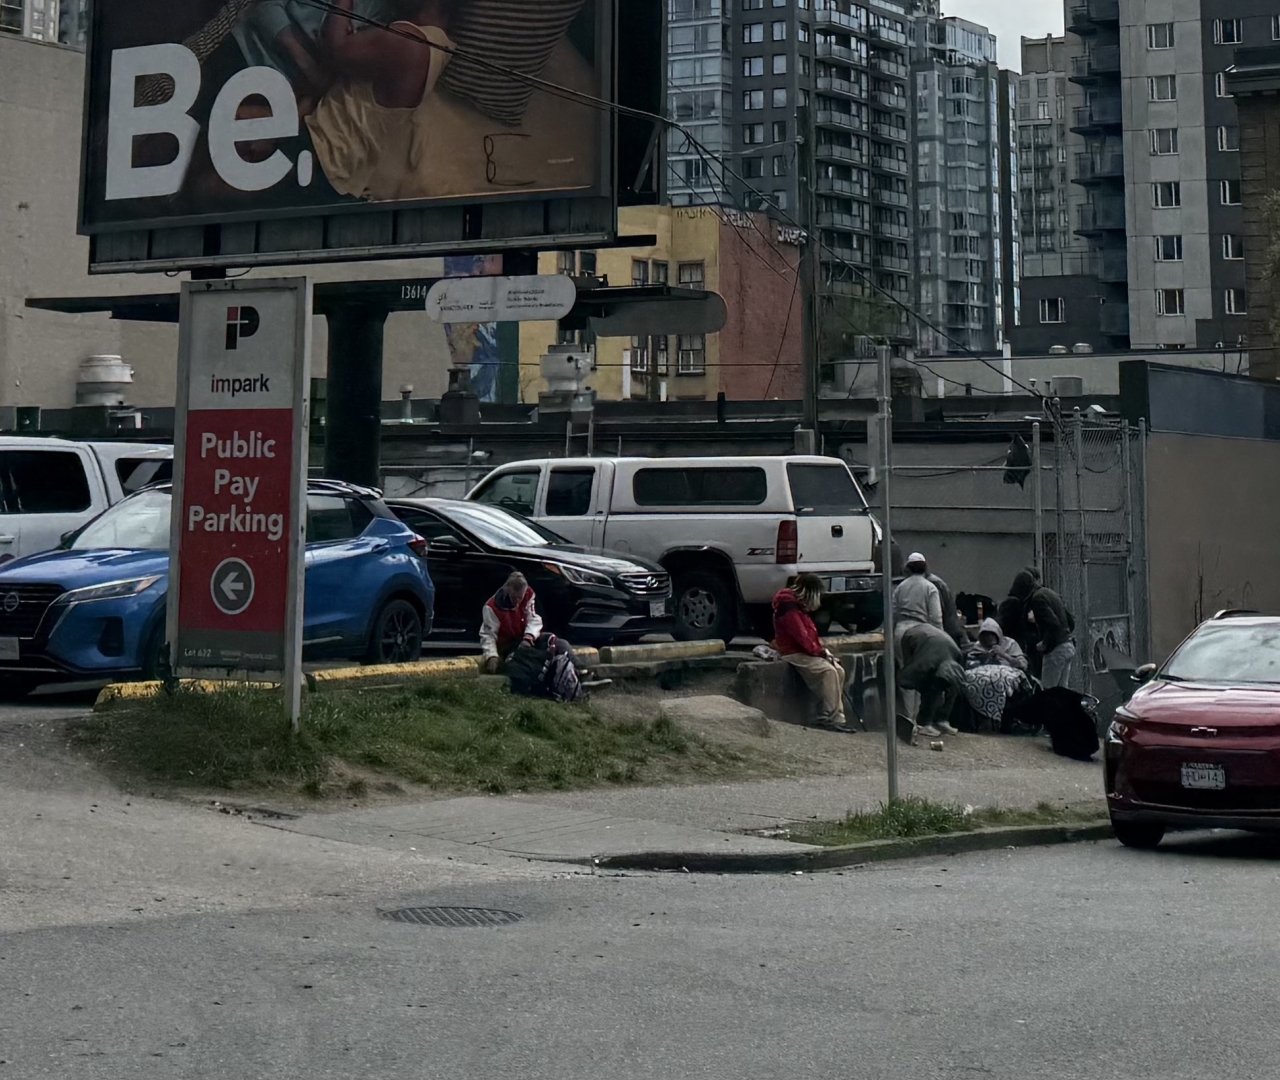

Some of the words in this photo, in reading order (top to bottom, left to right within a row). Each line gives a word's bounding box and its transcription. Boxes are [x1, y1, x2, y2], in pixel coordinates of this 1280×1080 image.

[105, 42, 312, 201] Be.
[401, 286, 427, 299] 13614
[211, 373, 270, 399] impark
[201, 430, 276, 460] Public
[214, 468, 260, 504] Pay
[188, 505, 284, 541] Parking
